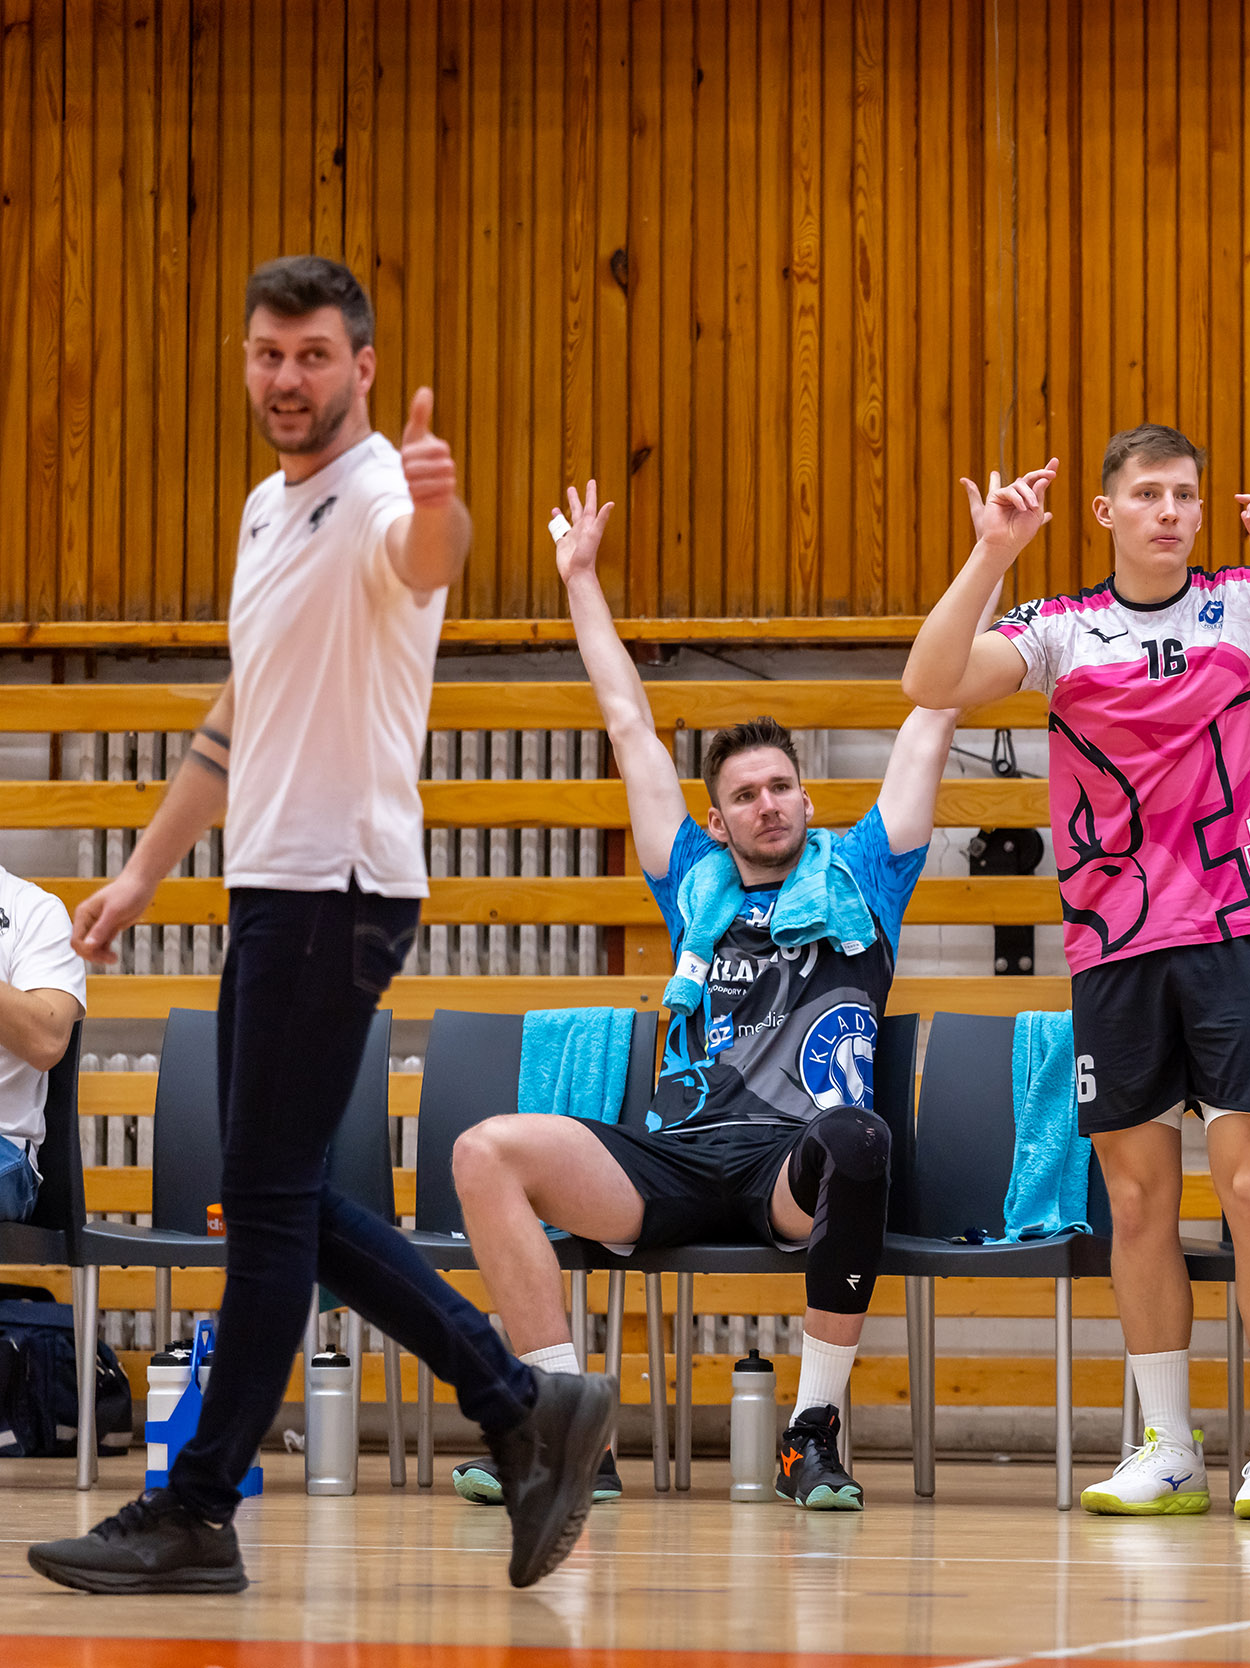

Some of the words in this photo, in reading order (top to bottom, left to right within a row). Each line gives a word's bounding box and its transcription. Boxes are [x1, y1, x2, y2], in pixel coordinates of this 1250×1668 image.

[1140, 637, 1189, 681] 16
[708, 1026, 732, 1049] gz
[809, 1013, 876, 1064] KLAD
